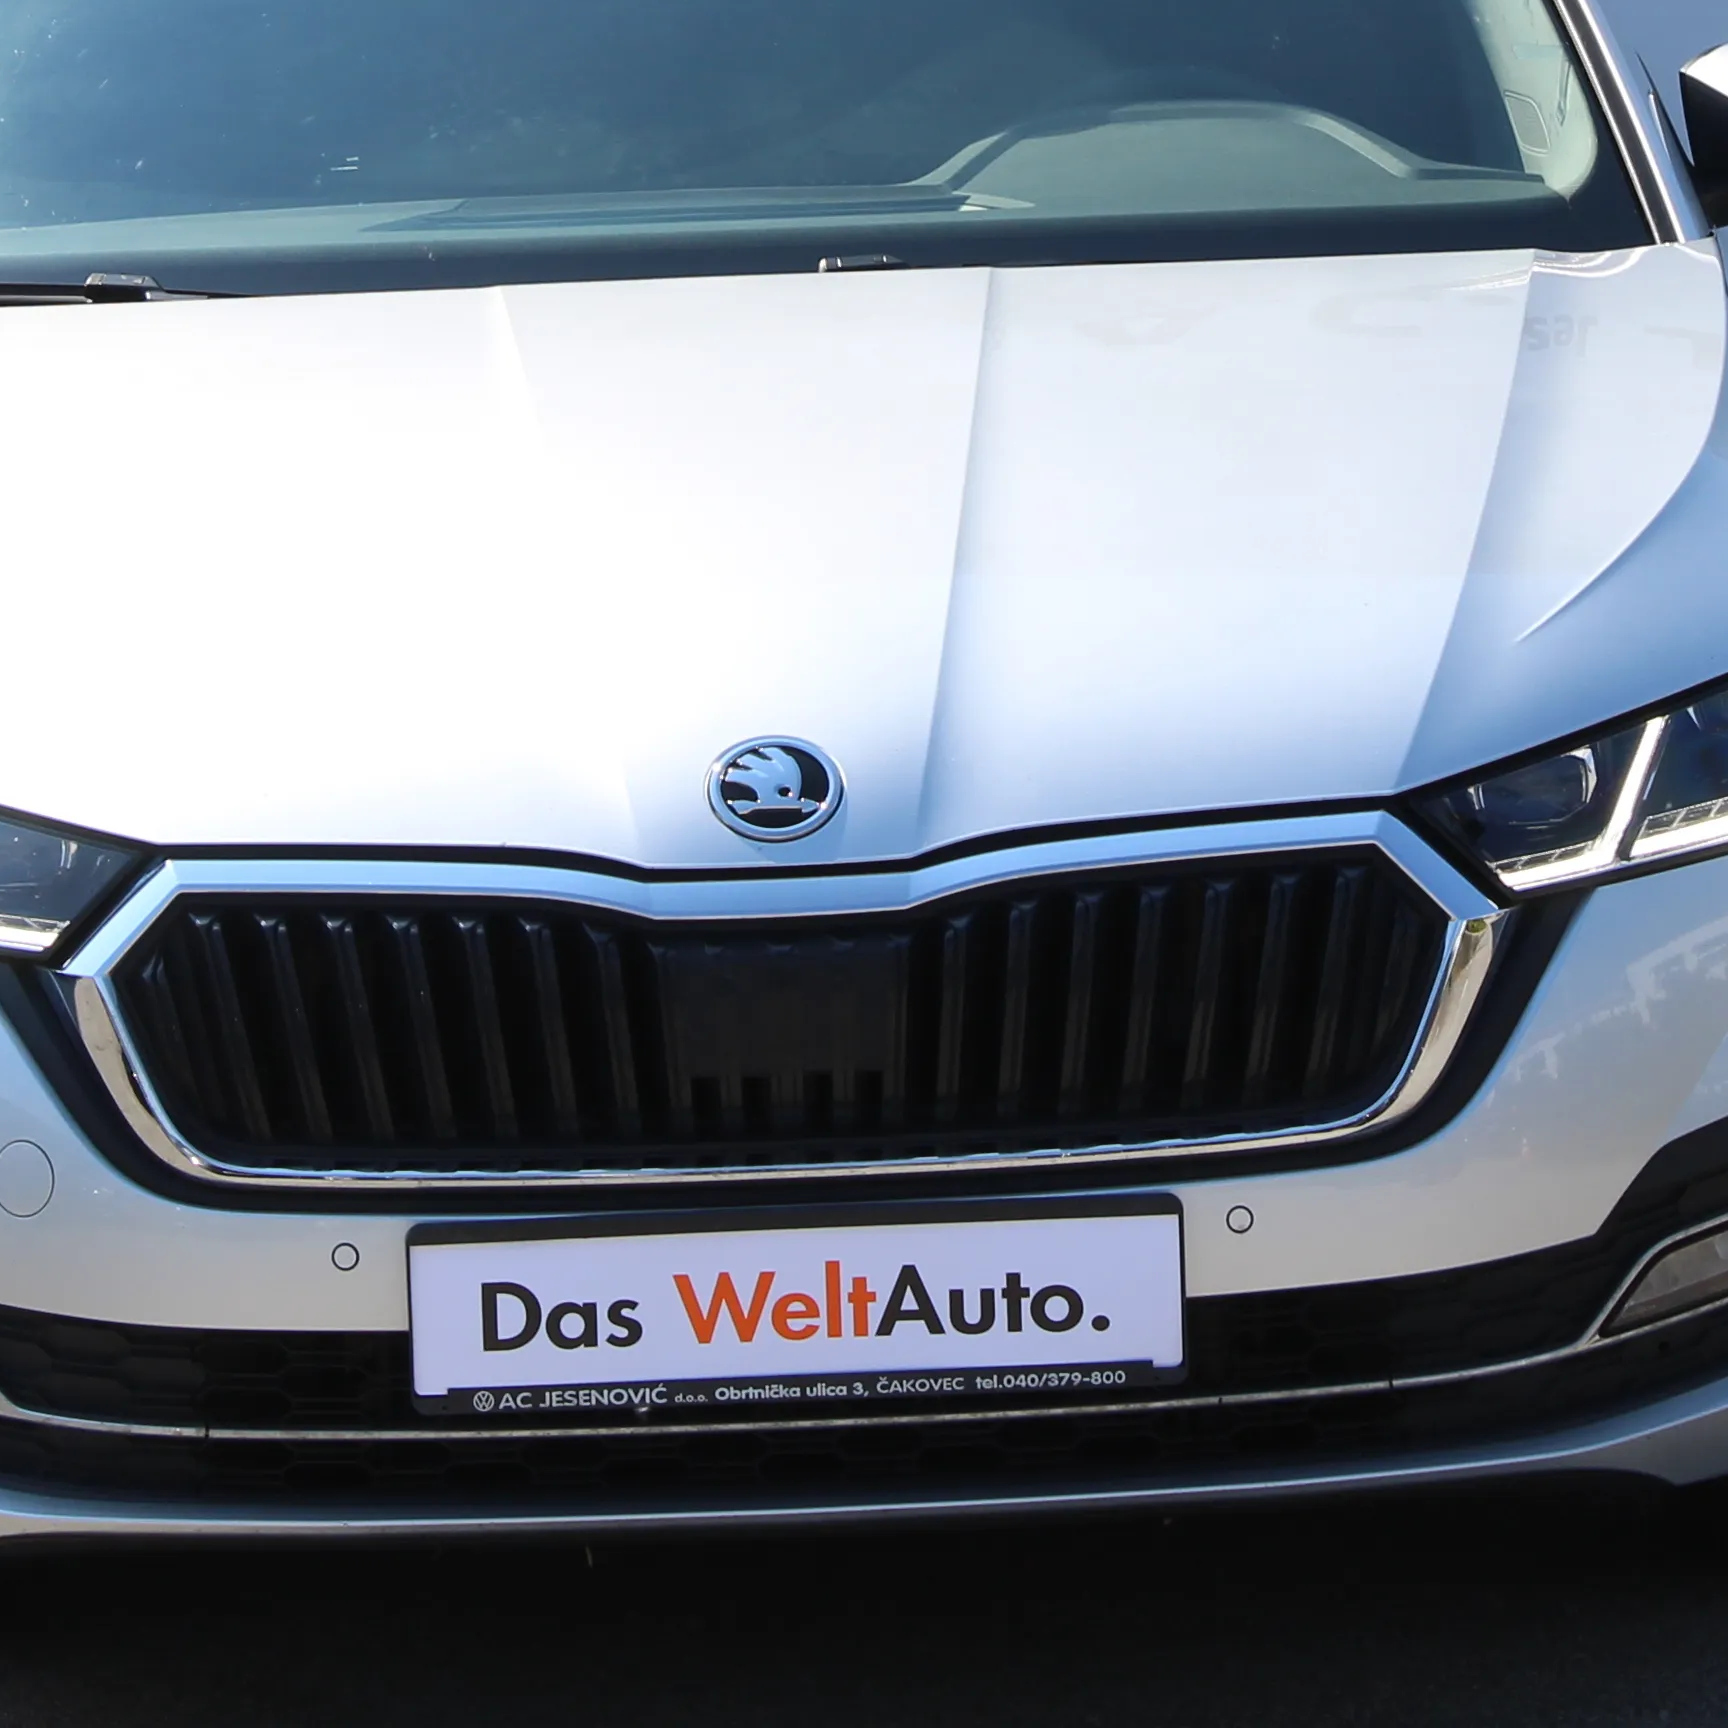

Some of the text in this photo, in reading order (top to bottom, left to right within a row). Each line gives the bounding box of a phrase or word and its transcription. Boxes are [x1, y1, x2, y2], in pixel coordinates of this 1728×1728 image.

[482, 1261, 1110, 1351] Das WeltAuto.
[499, 1392, 532, 1409] AC
[539, 1383, 668, 1408] JESENOVIĆ
[674, 1392, 709, 1403] d.o.o.
[715, 1383, 801, 1401] Obrtnička
[806, 1382, 847, 1397] ulica
[852, 1382, 869, 1397] 3,
[876, 1377, 965, 1394] ČAKOVEC
